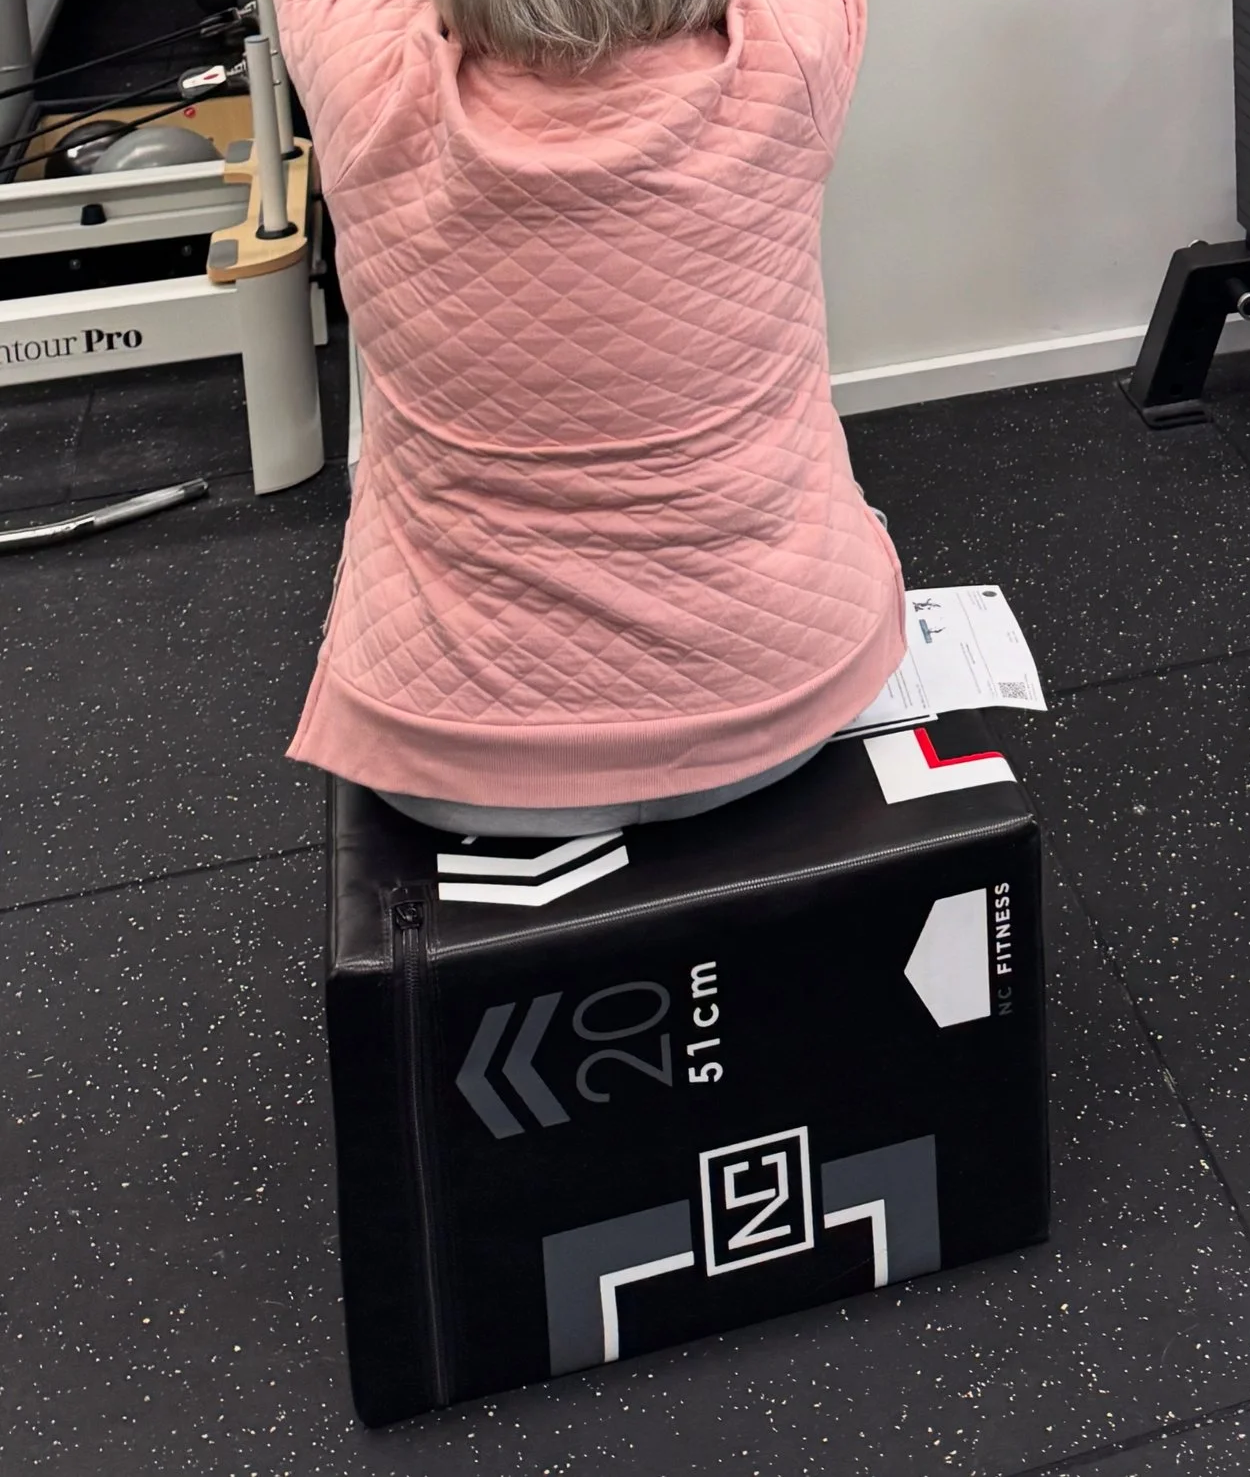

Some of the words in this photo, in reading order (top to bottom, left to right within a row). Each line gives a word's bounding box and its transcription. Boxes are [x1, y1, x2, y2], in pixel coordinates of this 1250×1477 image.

[81, 328, 143, 354] Pro
[995, 881, 1011, 974] FITNESS
[571, 979, 675, 1105] 20
[688, 958, 721, 1084] 51cm
[995, 986, 1013, 1015] NC
[723, 1150, 791, 1251] NC
